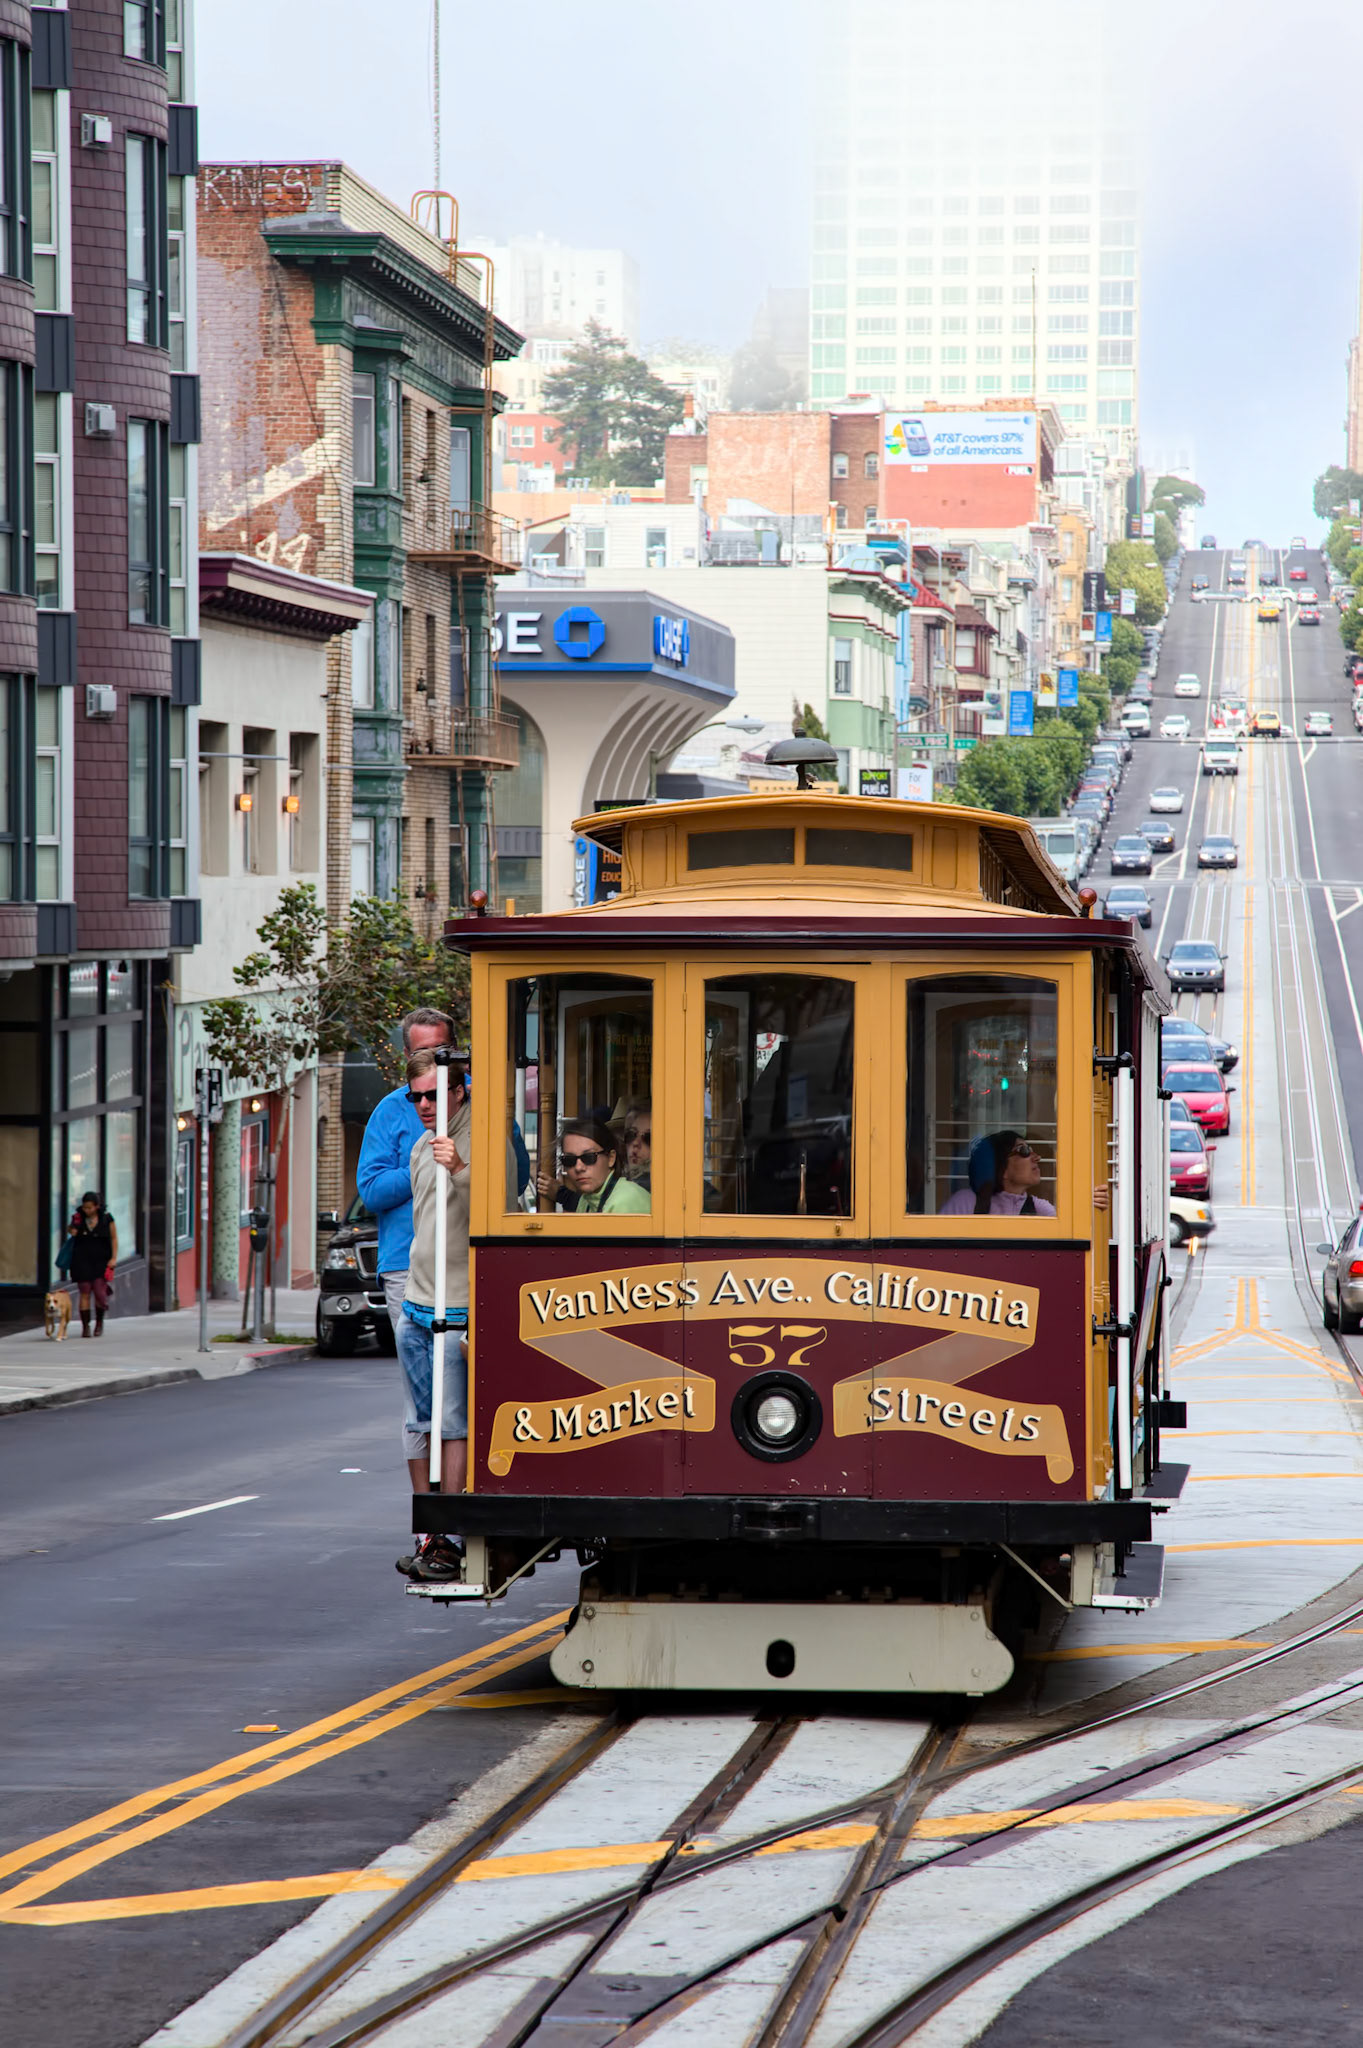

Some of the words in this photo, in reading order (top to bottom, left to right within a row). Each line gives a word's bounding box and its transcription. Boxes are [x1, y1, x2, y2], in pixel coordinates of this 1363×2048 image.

[933, 433, 962, 443] AT&T
[963, 435, 999, 443] covers
[1001, 433, 1023, 443] 97%
[933, 446, 946, 456] of
[946, 445, 961, 456] all
[962, 446, 1023, 456] Americans.
[861, 784, 889, 796] PULIC
[529, 1288, 598, 1324] Van
[600, 1277, 700, 1315] Ness
[825, 1271, 1030, 1328] California
[728, 1324, 828, 1367] 57
[514, 1407, 543, 1441] &
[548, 1386, 697, 1442] Market
[867, 1387, 1042, 1441] Streets
